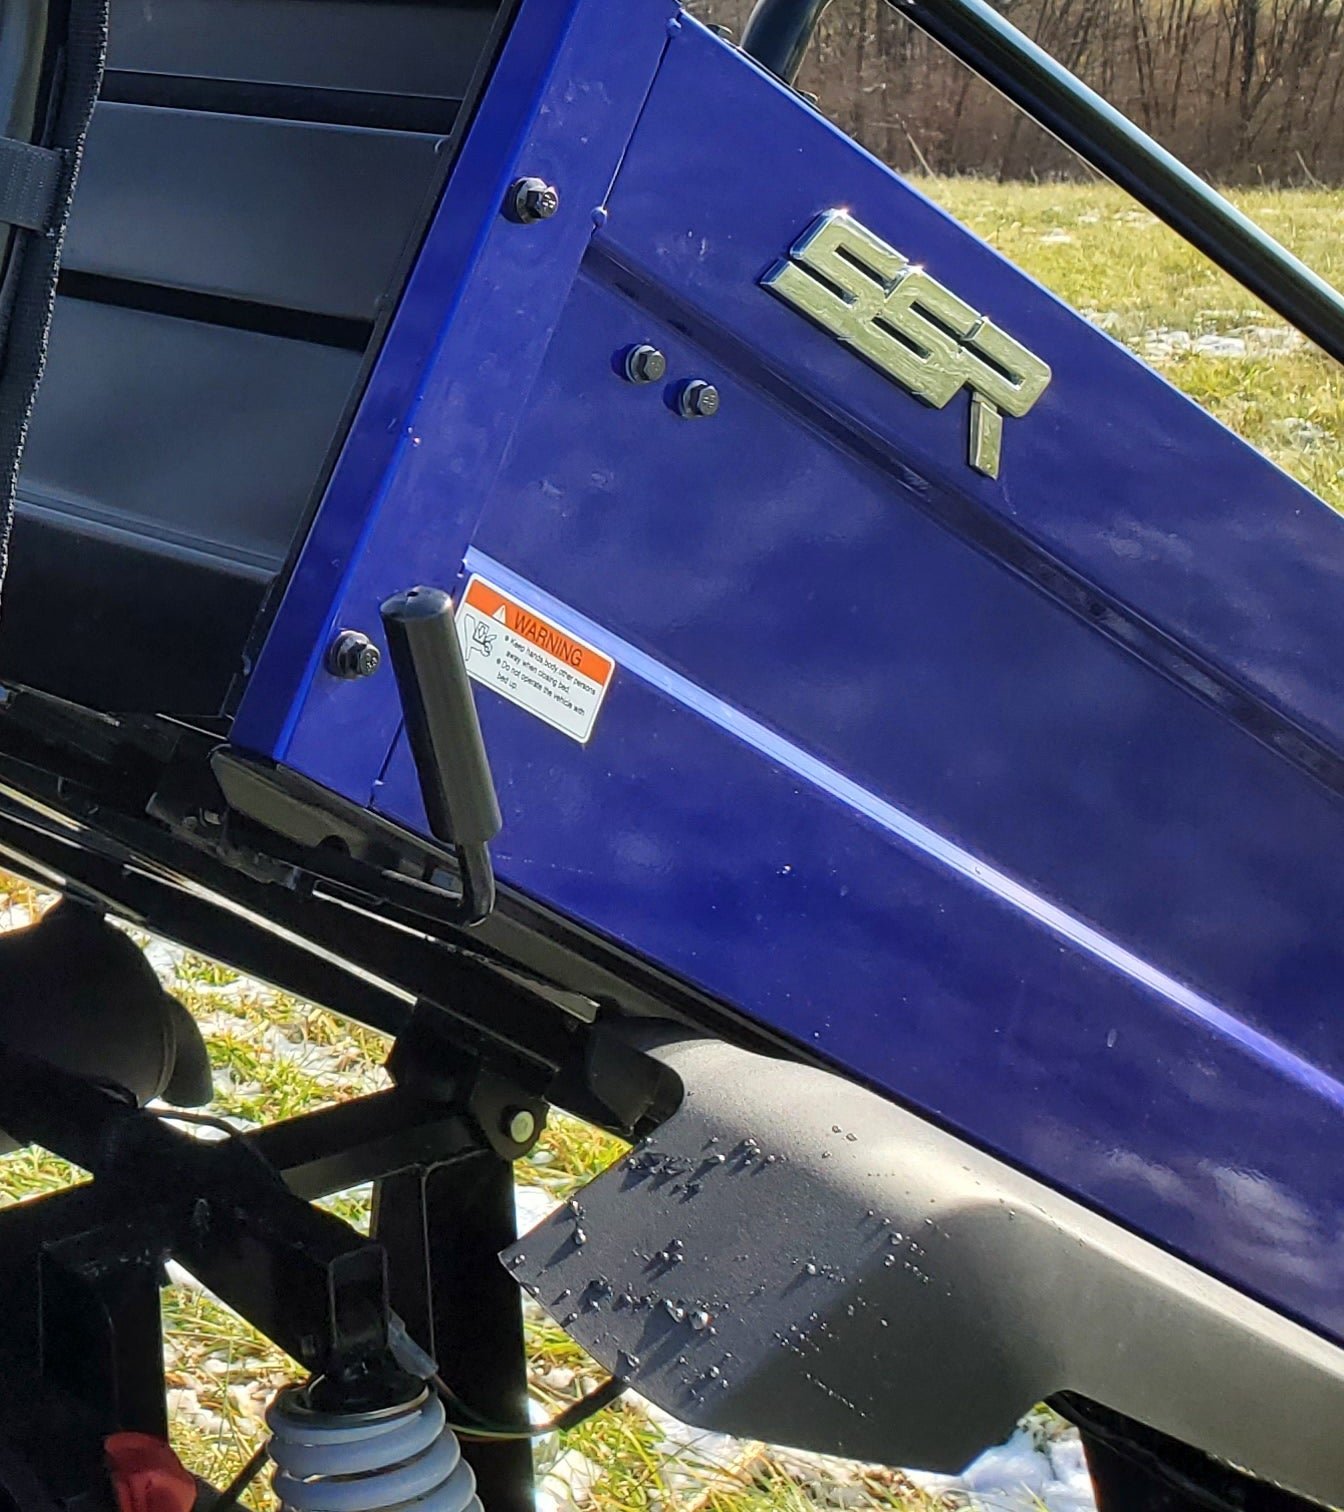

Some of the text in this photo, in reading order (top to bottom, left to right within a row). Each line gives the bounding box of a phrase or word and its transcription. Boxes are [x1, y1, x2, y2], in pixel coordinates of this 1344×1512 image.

[761, 207, 1052, 481] SSR
[514, 611, 583, 667] WARNING
[521, 673, 543, 691] operate
[543, 686, 553, 697] the
[553, 692, 573, 709] vehicle
[573, 678, 596, 696] persons
